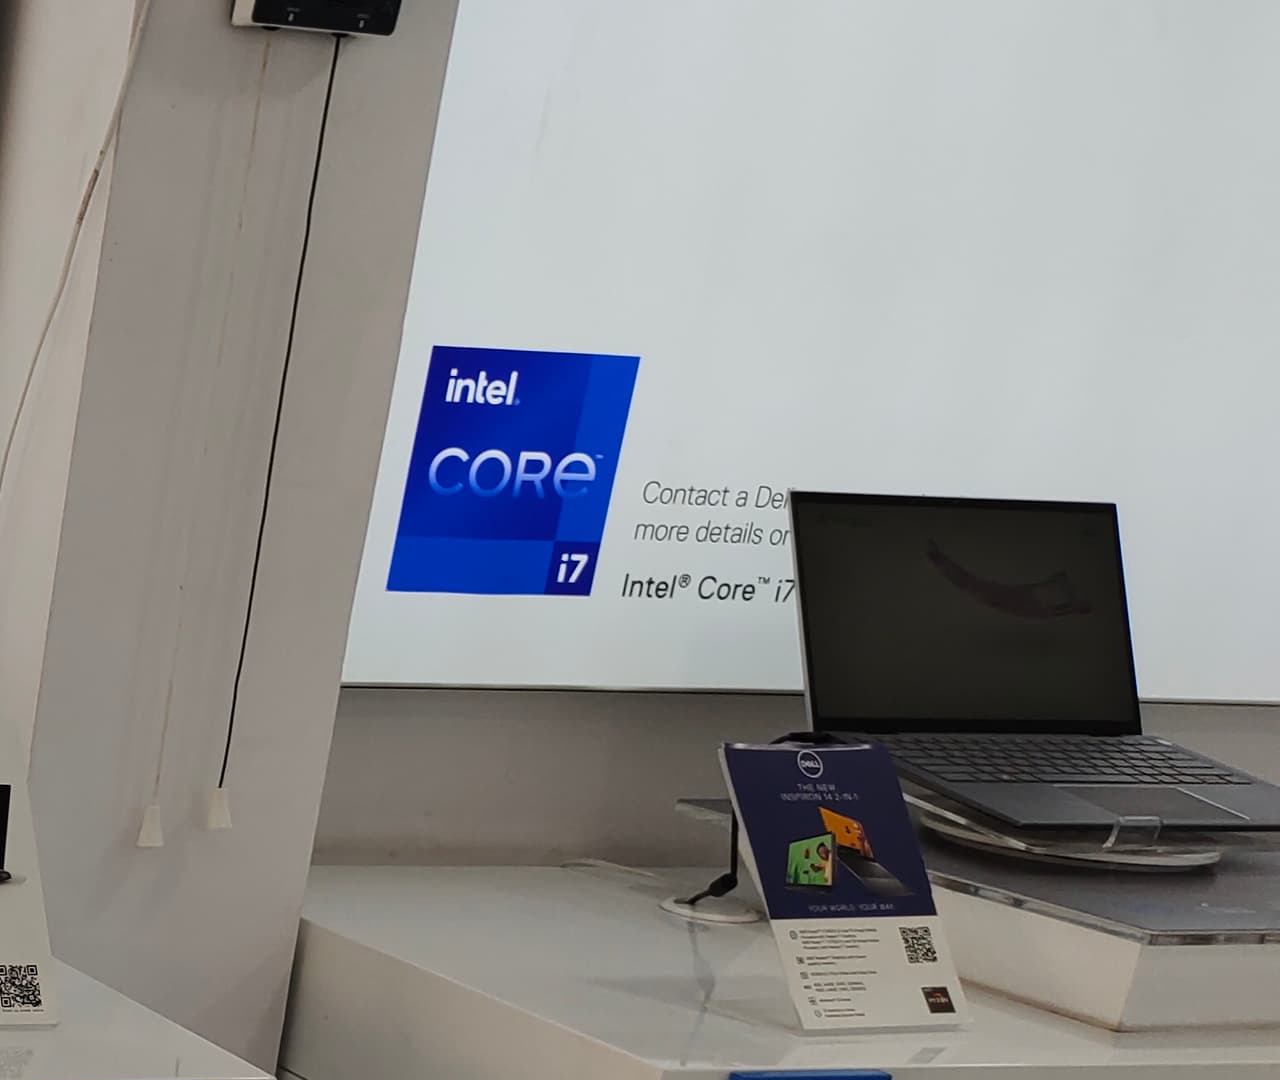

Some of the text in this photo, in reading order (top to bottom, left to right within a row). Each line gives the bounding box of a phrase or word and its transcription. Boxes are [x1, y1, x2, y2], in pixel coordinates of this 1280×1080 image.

[642, 481, 730, 506] Contact
[735, 490, 749, 508] a
[634, 522, 690, 543] more
[695, 520, 764, 545] details
[557, 553, 589, 583] i7
[774, 578, 797, 603] i7
